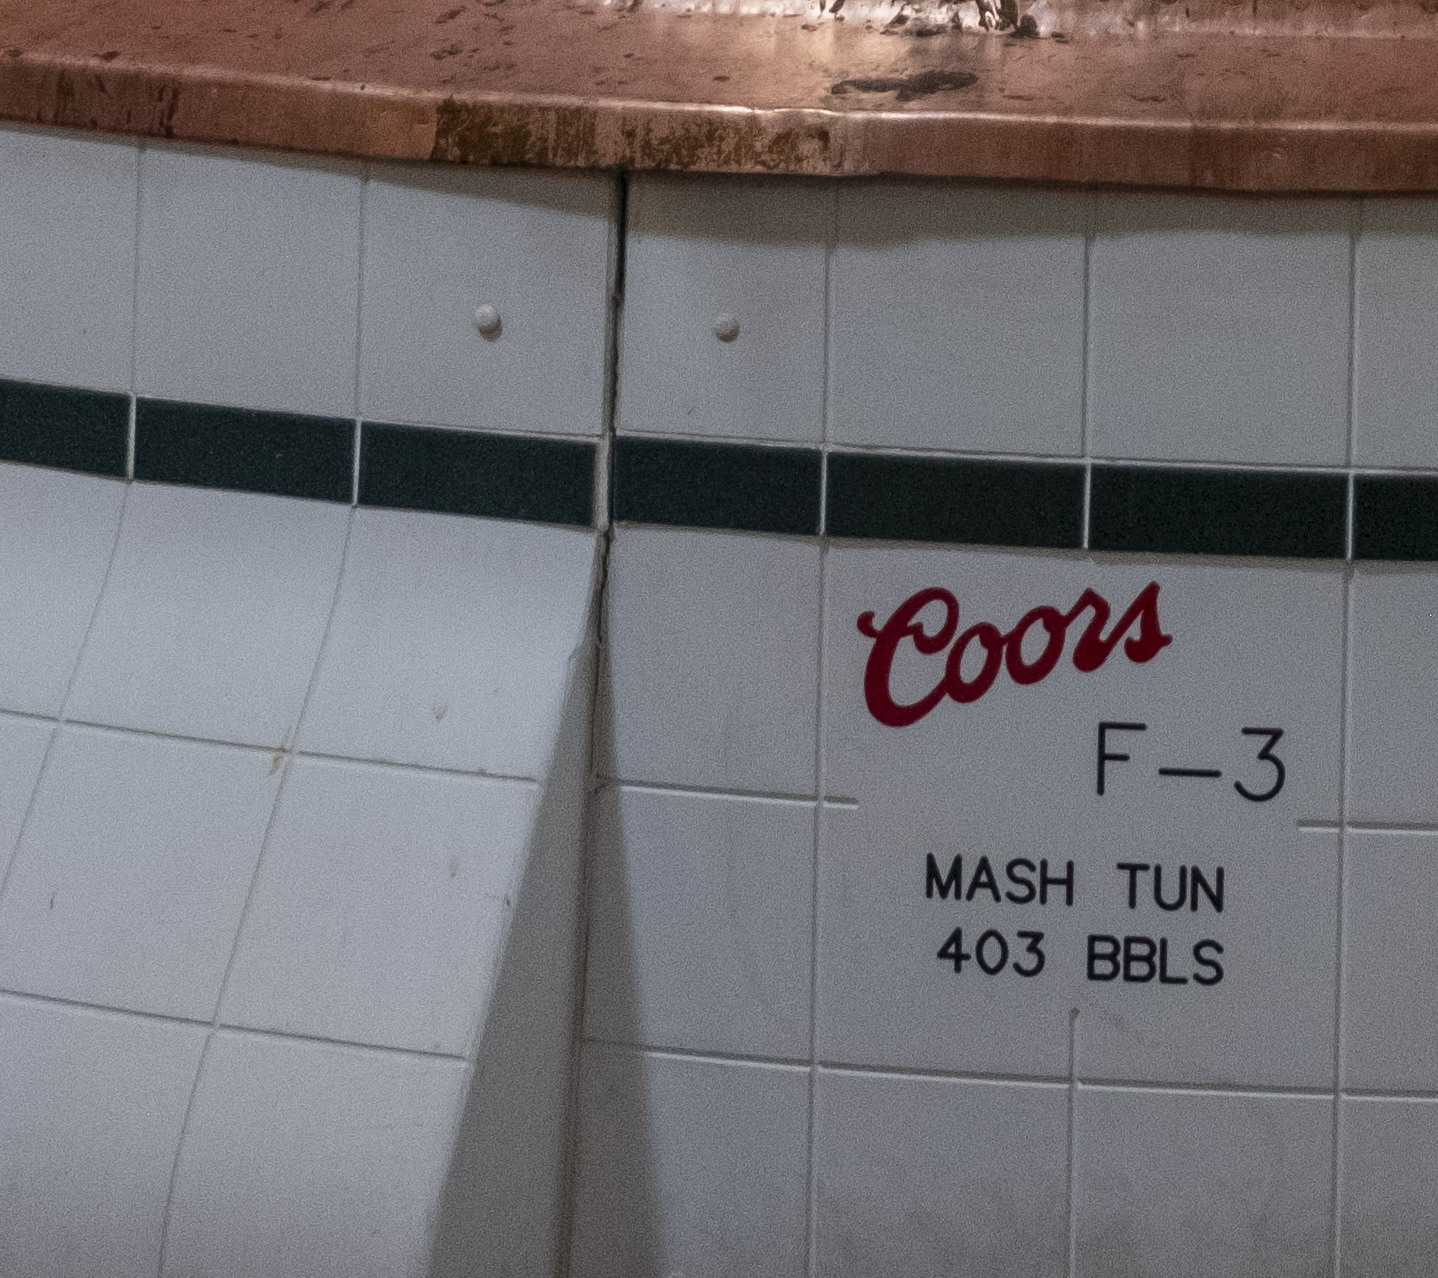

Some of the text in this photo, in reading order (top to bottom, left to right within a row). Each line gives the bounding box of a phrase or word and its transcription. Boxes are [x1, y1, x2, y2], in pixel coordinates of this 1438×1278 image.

[856, 580, 1173, 727] Coors
[1095, 721, 1287, 802] F-3
[925, 852, 1225, 913] MASH TUN
[936, 927, 1225, 986] 403 BBLS
